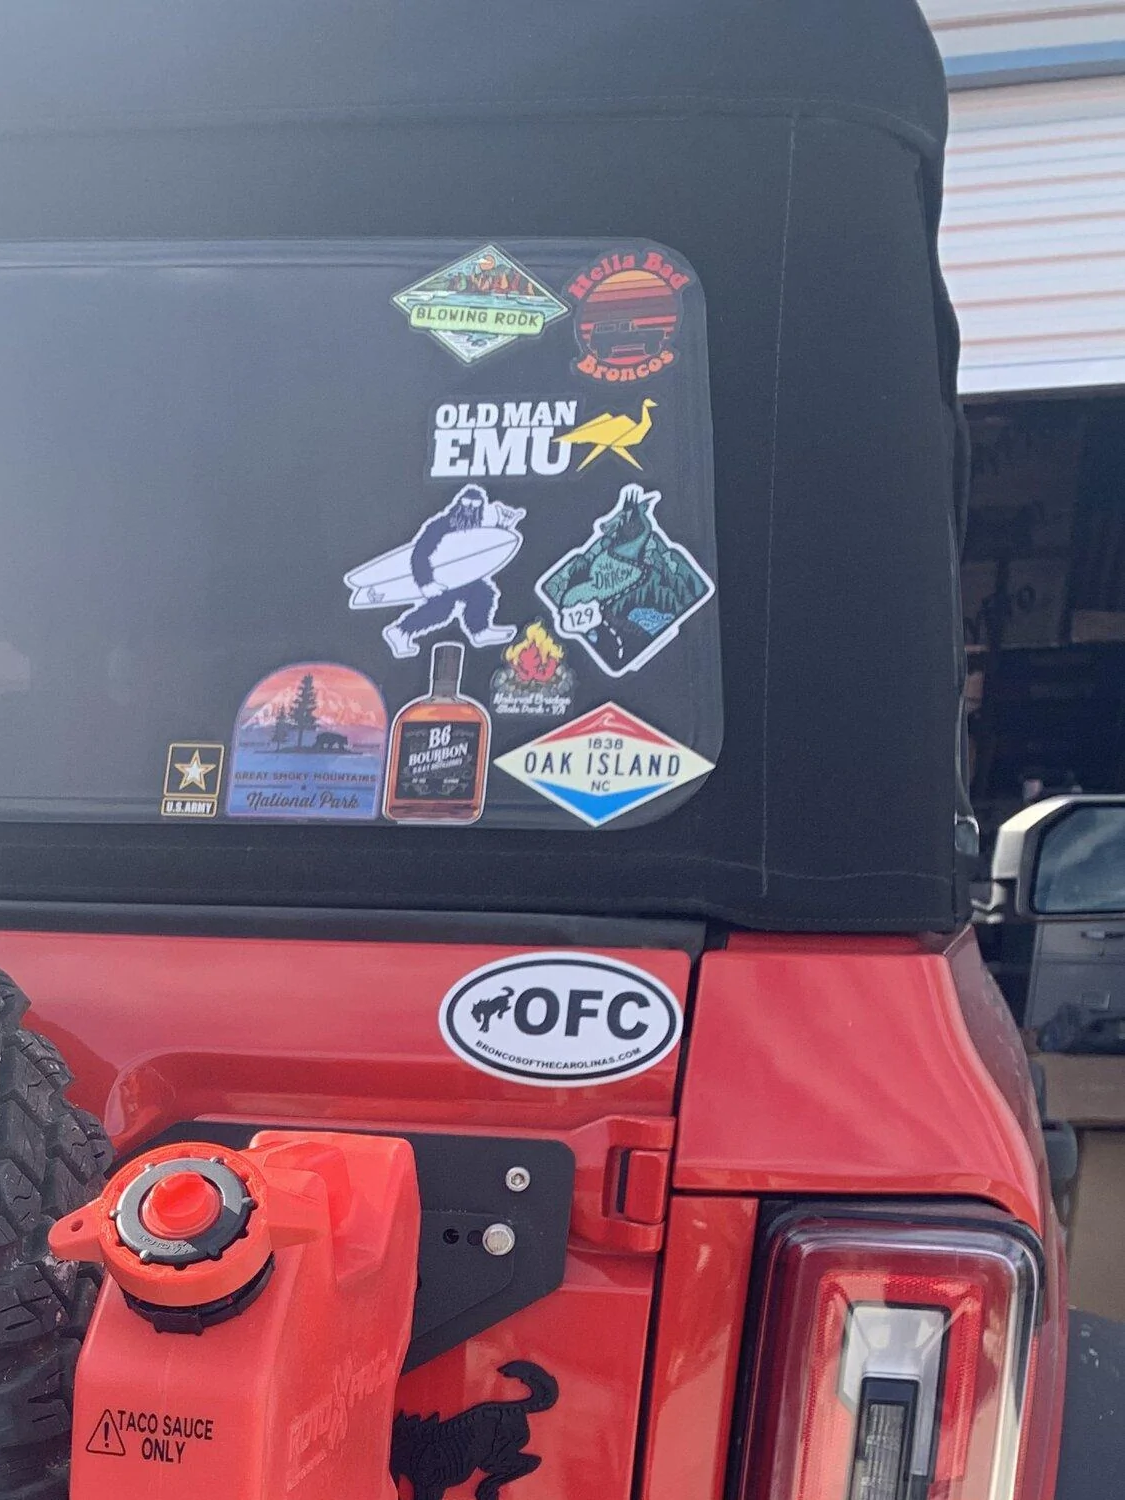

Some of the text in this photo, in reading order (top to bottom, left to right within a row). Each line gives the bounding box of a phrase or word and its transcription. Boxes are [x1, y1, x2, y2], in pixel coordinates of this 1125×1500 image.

[567, 250, 690, 299] Hella Bad
[415, 306, 487, 324] BLOWING
[577, 349, 675, 383] Broncos
[435, 400, 577, 428] OLD MAN
[430, 426, 574, 477] EMU
[568, 607, 595, 627] 129
[408, 741, 469, 767] BOURBON
[587, 736, 624, 751] 1838
[524, 752, 682, 778] OAK ISLAND
[590, 779, 611, 792] NC
[246, 790, 360, 811] National Park
[513, 986, 651, 1041] OFC
[475, 1038, 642, 1071] BRONCOSOFTHECAROLINAS.COM
[117, 1409, 214, 1441] TACO SAUCE
[141, 1441, 187, 1464] ONLY
